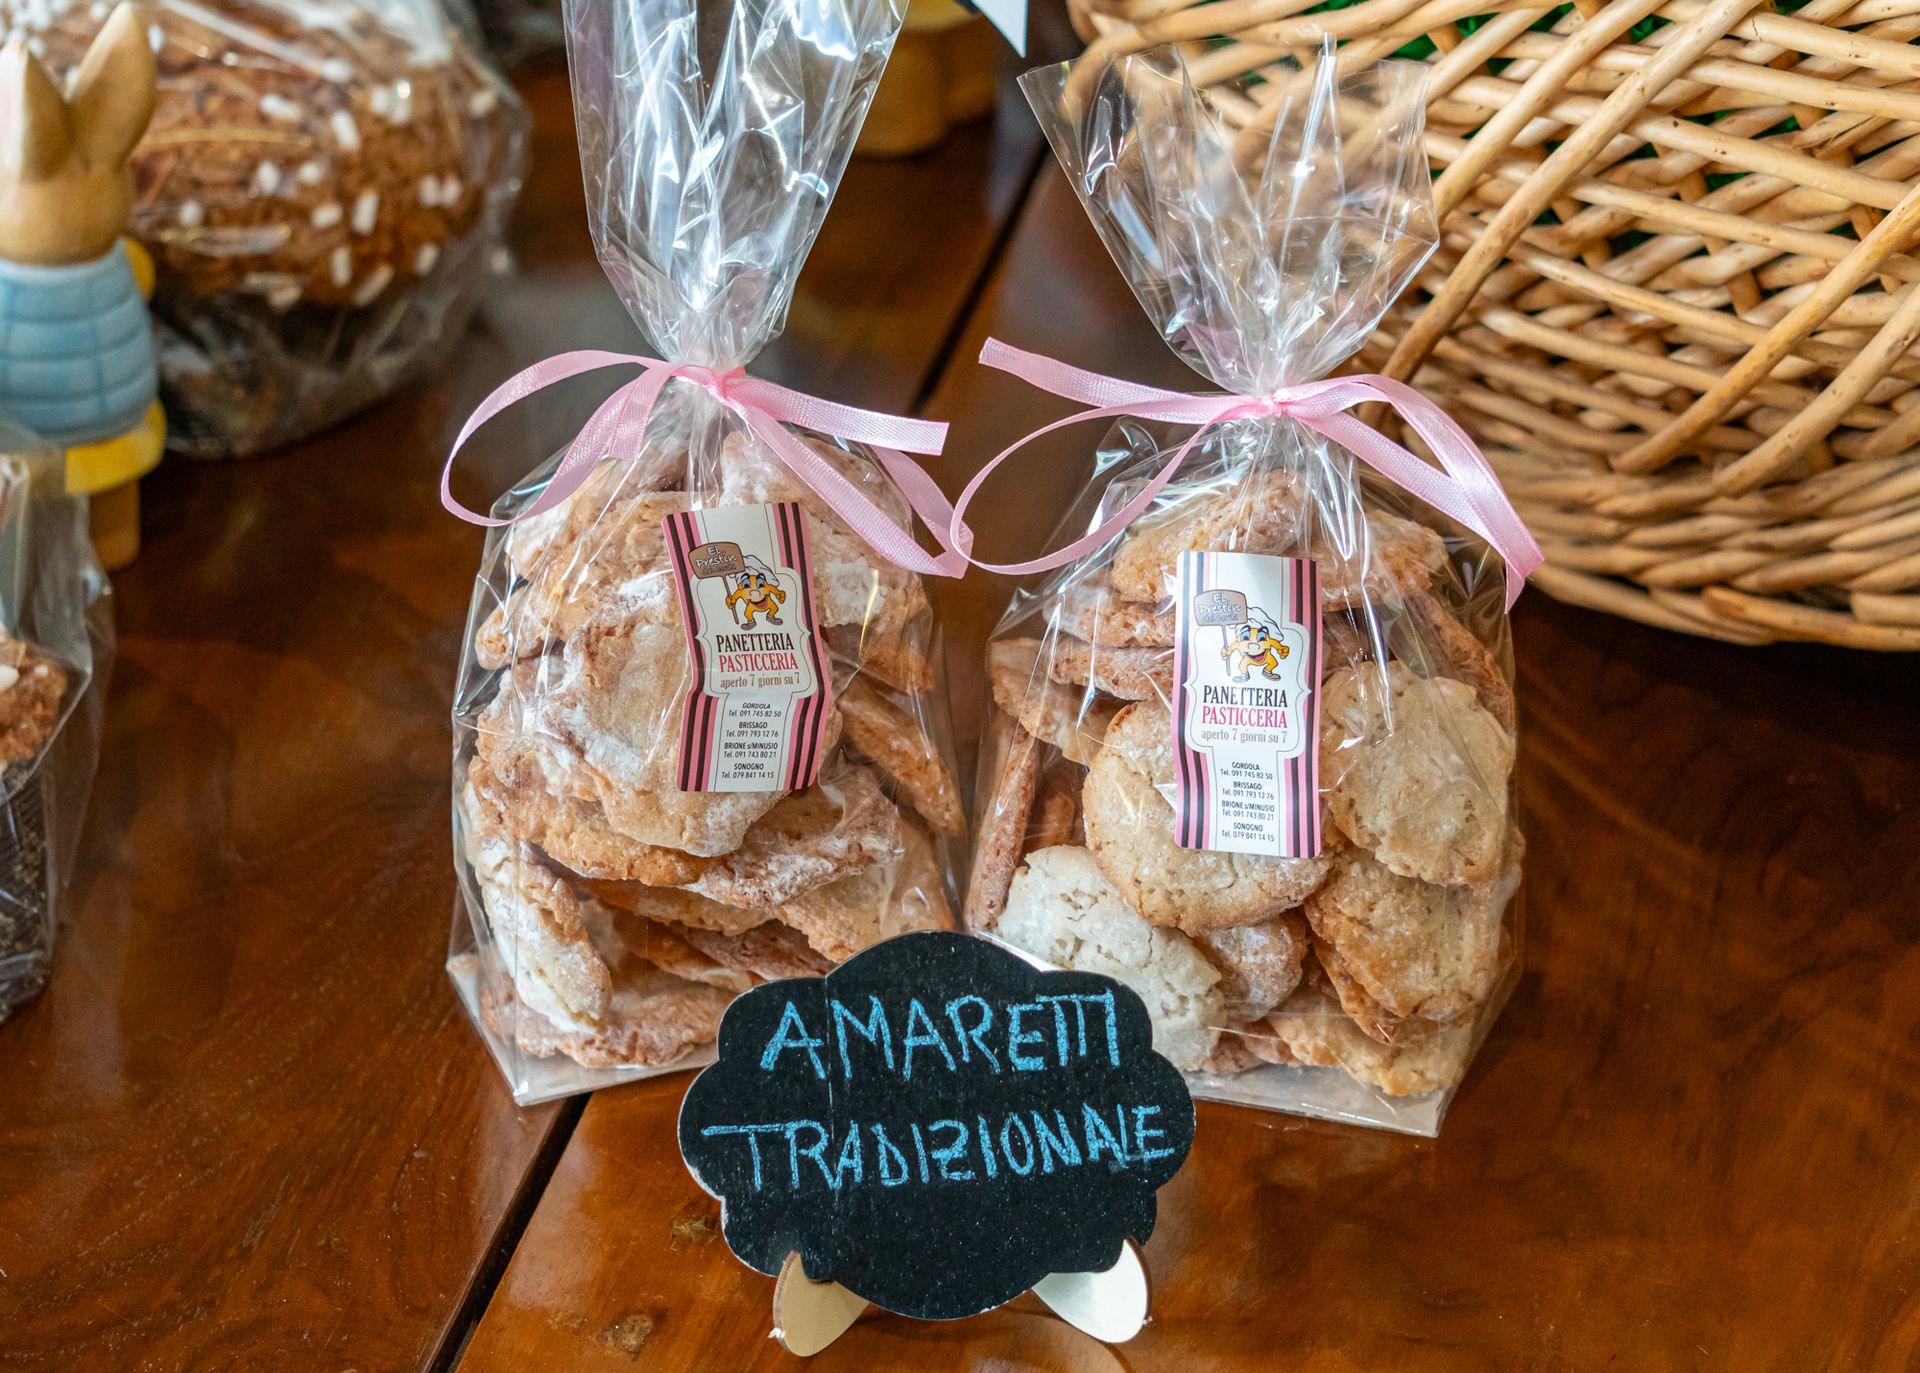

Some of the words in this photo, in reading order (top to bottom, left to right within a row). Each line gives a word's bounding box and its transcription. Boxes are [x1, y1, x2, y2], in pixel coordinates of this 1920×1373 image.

[708, 545, 720, 555] El
[1214, 593, 1226, 603] El
[716, 633, 794, 652] PANETTERIA
[719, 652, 798, 672] PASTICCERIA
[720, 677, 747, 689] aperto
[750, 674, 755, 686] 7
[758, 674, 782, 688] giorni
[784, 676, 793, 684] su
[795, 672, 800, 684] 7
[1203, 685, 1288, 707] PANETTERIA
[1202, 706, 1288, 728] PASTICCERIA
[1201, 729, 1229, 741] aperto
[1232, 728, 1238, 740] 7
[1240, 729, 1266, 743] giorni
[1268, 734, 1278, 743] su
[1282, 731, 1287, 743] 7
[1232, 762, 1260, 770] GORDOLA
[1233, 781, 1262, 790] BRISSAGO
[1222, 800, 1243, 808] BRIONE
[1233, 822, 1263, 832] SONOGNO
[760, 990, 1121, 1080] AMARETTI
[700, 1103, 1175, 1191] TRADIZIONALE
